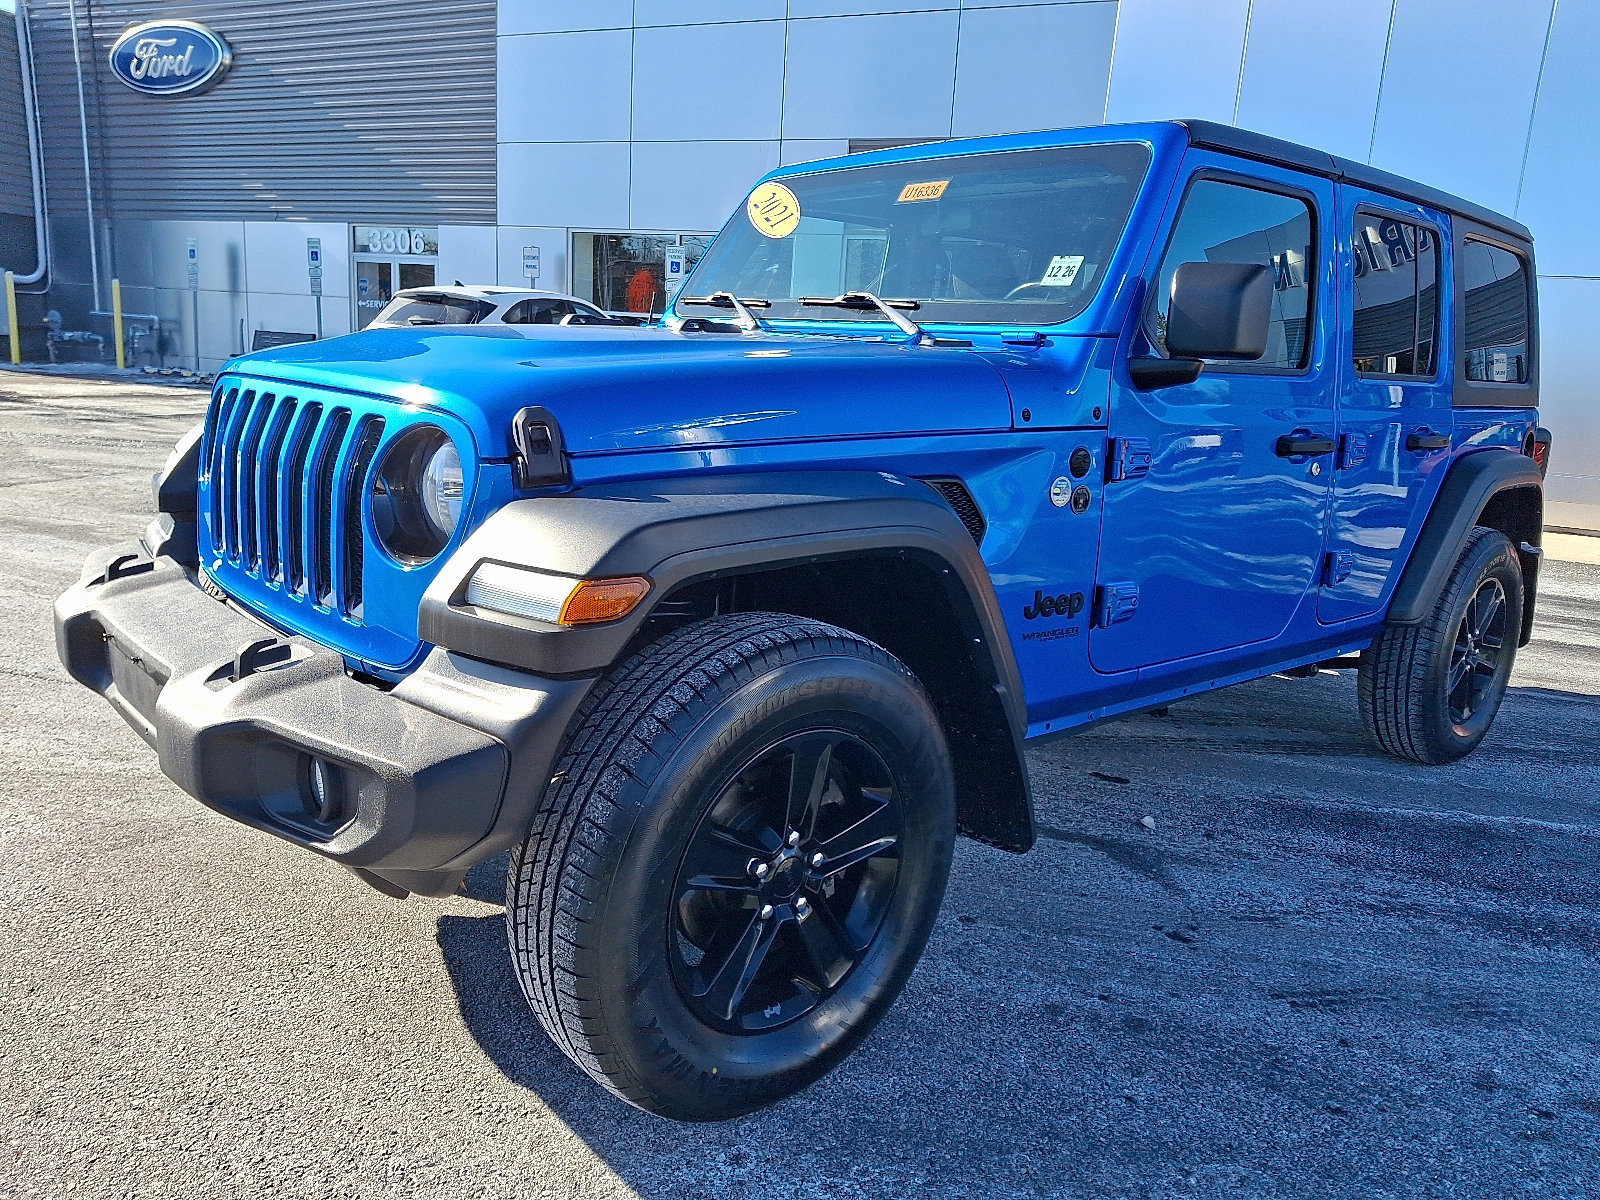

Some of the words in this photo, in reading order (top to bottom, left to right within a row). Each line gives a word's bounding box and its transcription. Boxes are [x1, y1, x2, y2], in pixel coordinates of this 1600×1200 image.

[130, 38, 194, 80] Ford
[904, 184, 942, 199] U16336
[753, 192, 794, 229] 2021
[368, 229, 425, 254] 3306
[1047, 265, 1062, 278] 12
[1061, 265, 1076, 278] 26
[1023, 590, 1085, 620] Jeep
[1022, 626, 1079, 641] WRANGLER
